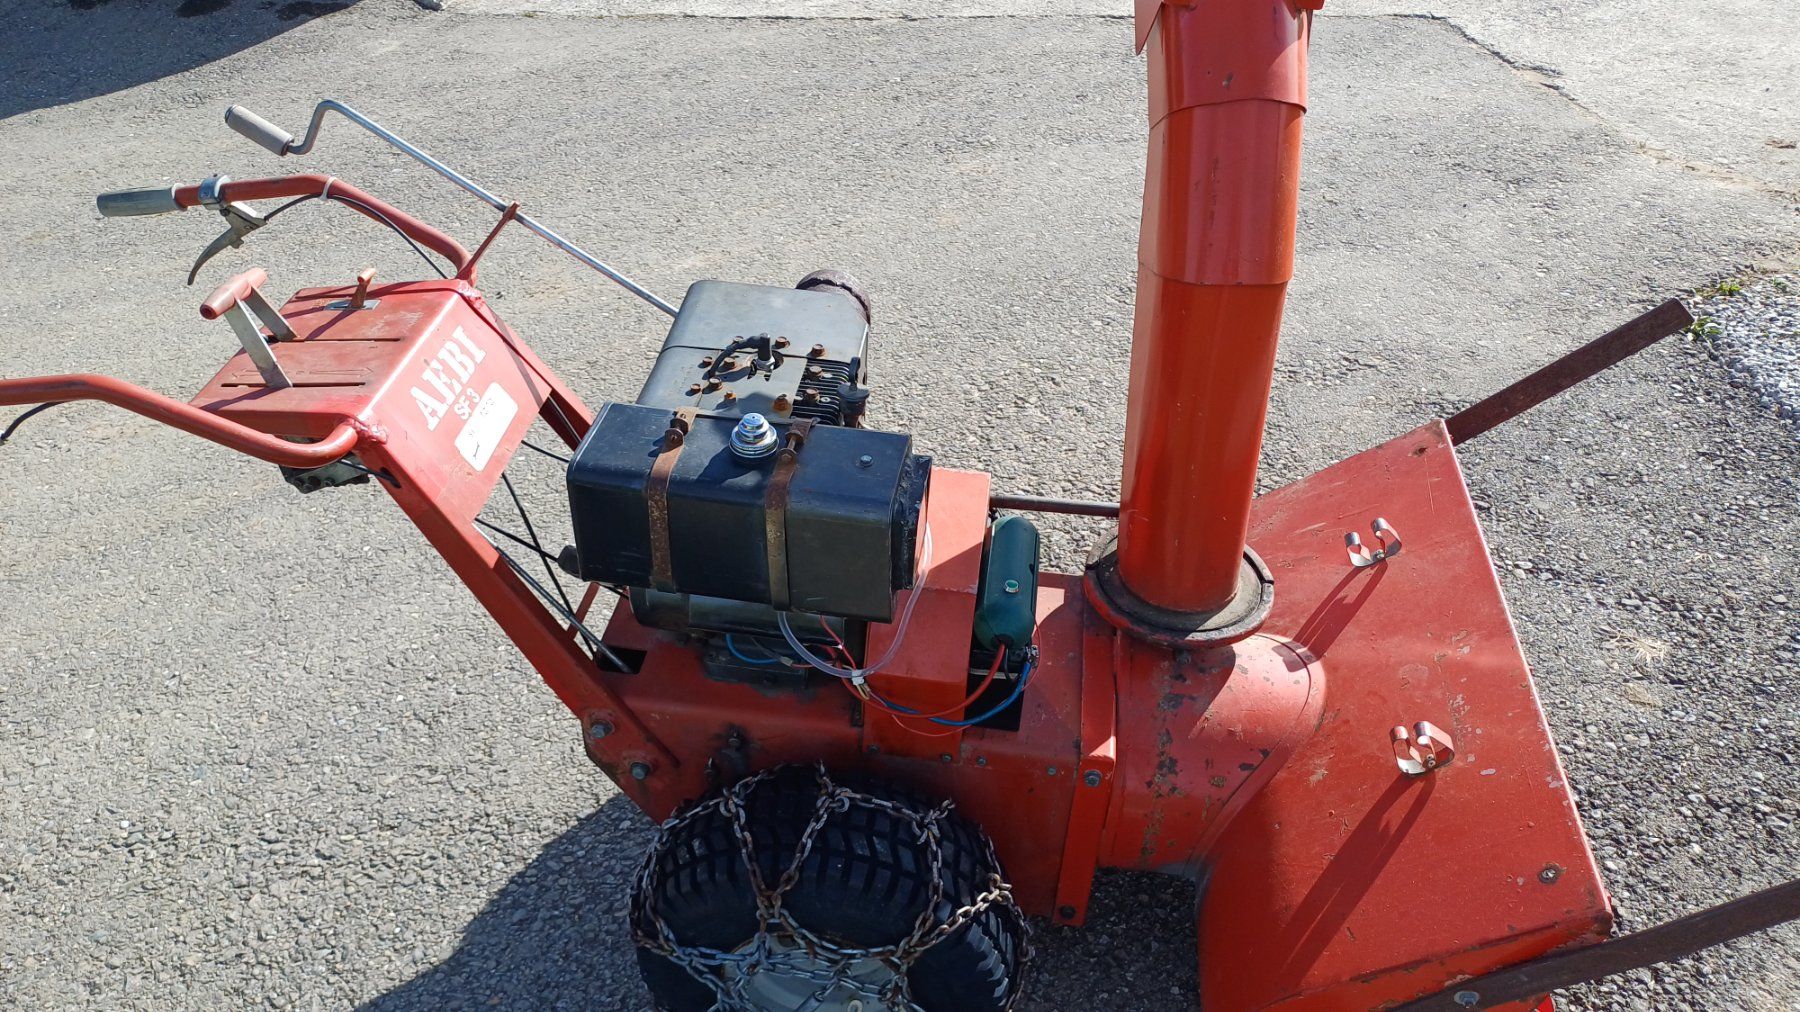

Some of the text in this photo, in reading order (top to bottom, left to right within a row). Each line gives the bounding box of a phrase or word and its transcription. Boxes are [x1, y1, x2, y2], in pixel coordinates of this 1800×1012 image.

[410, 325, 487, 432] AEBI
[454, 387, 481, 420] SF 3
